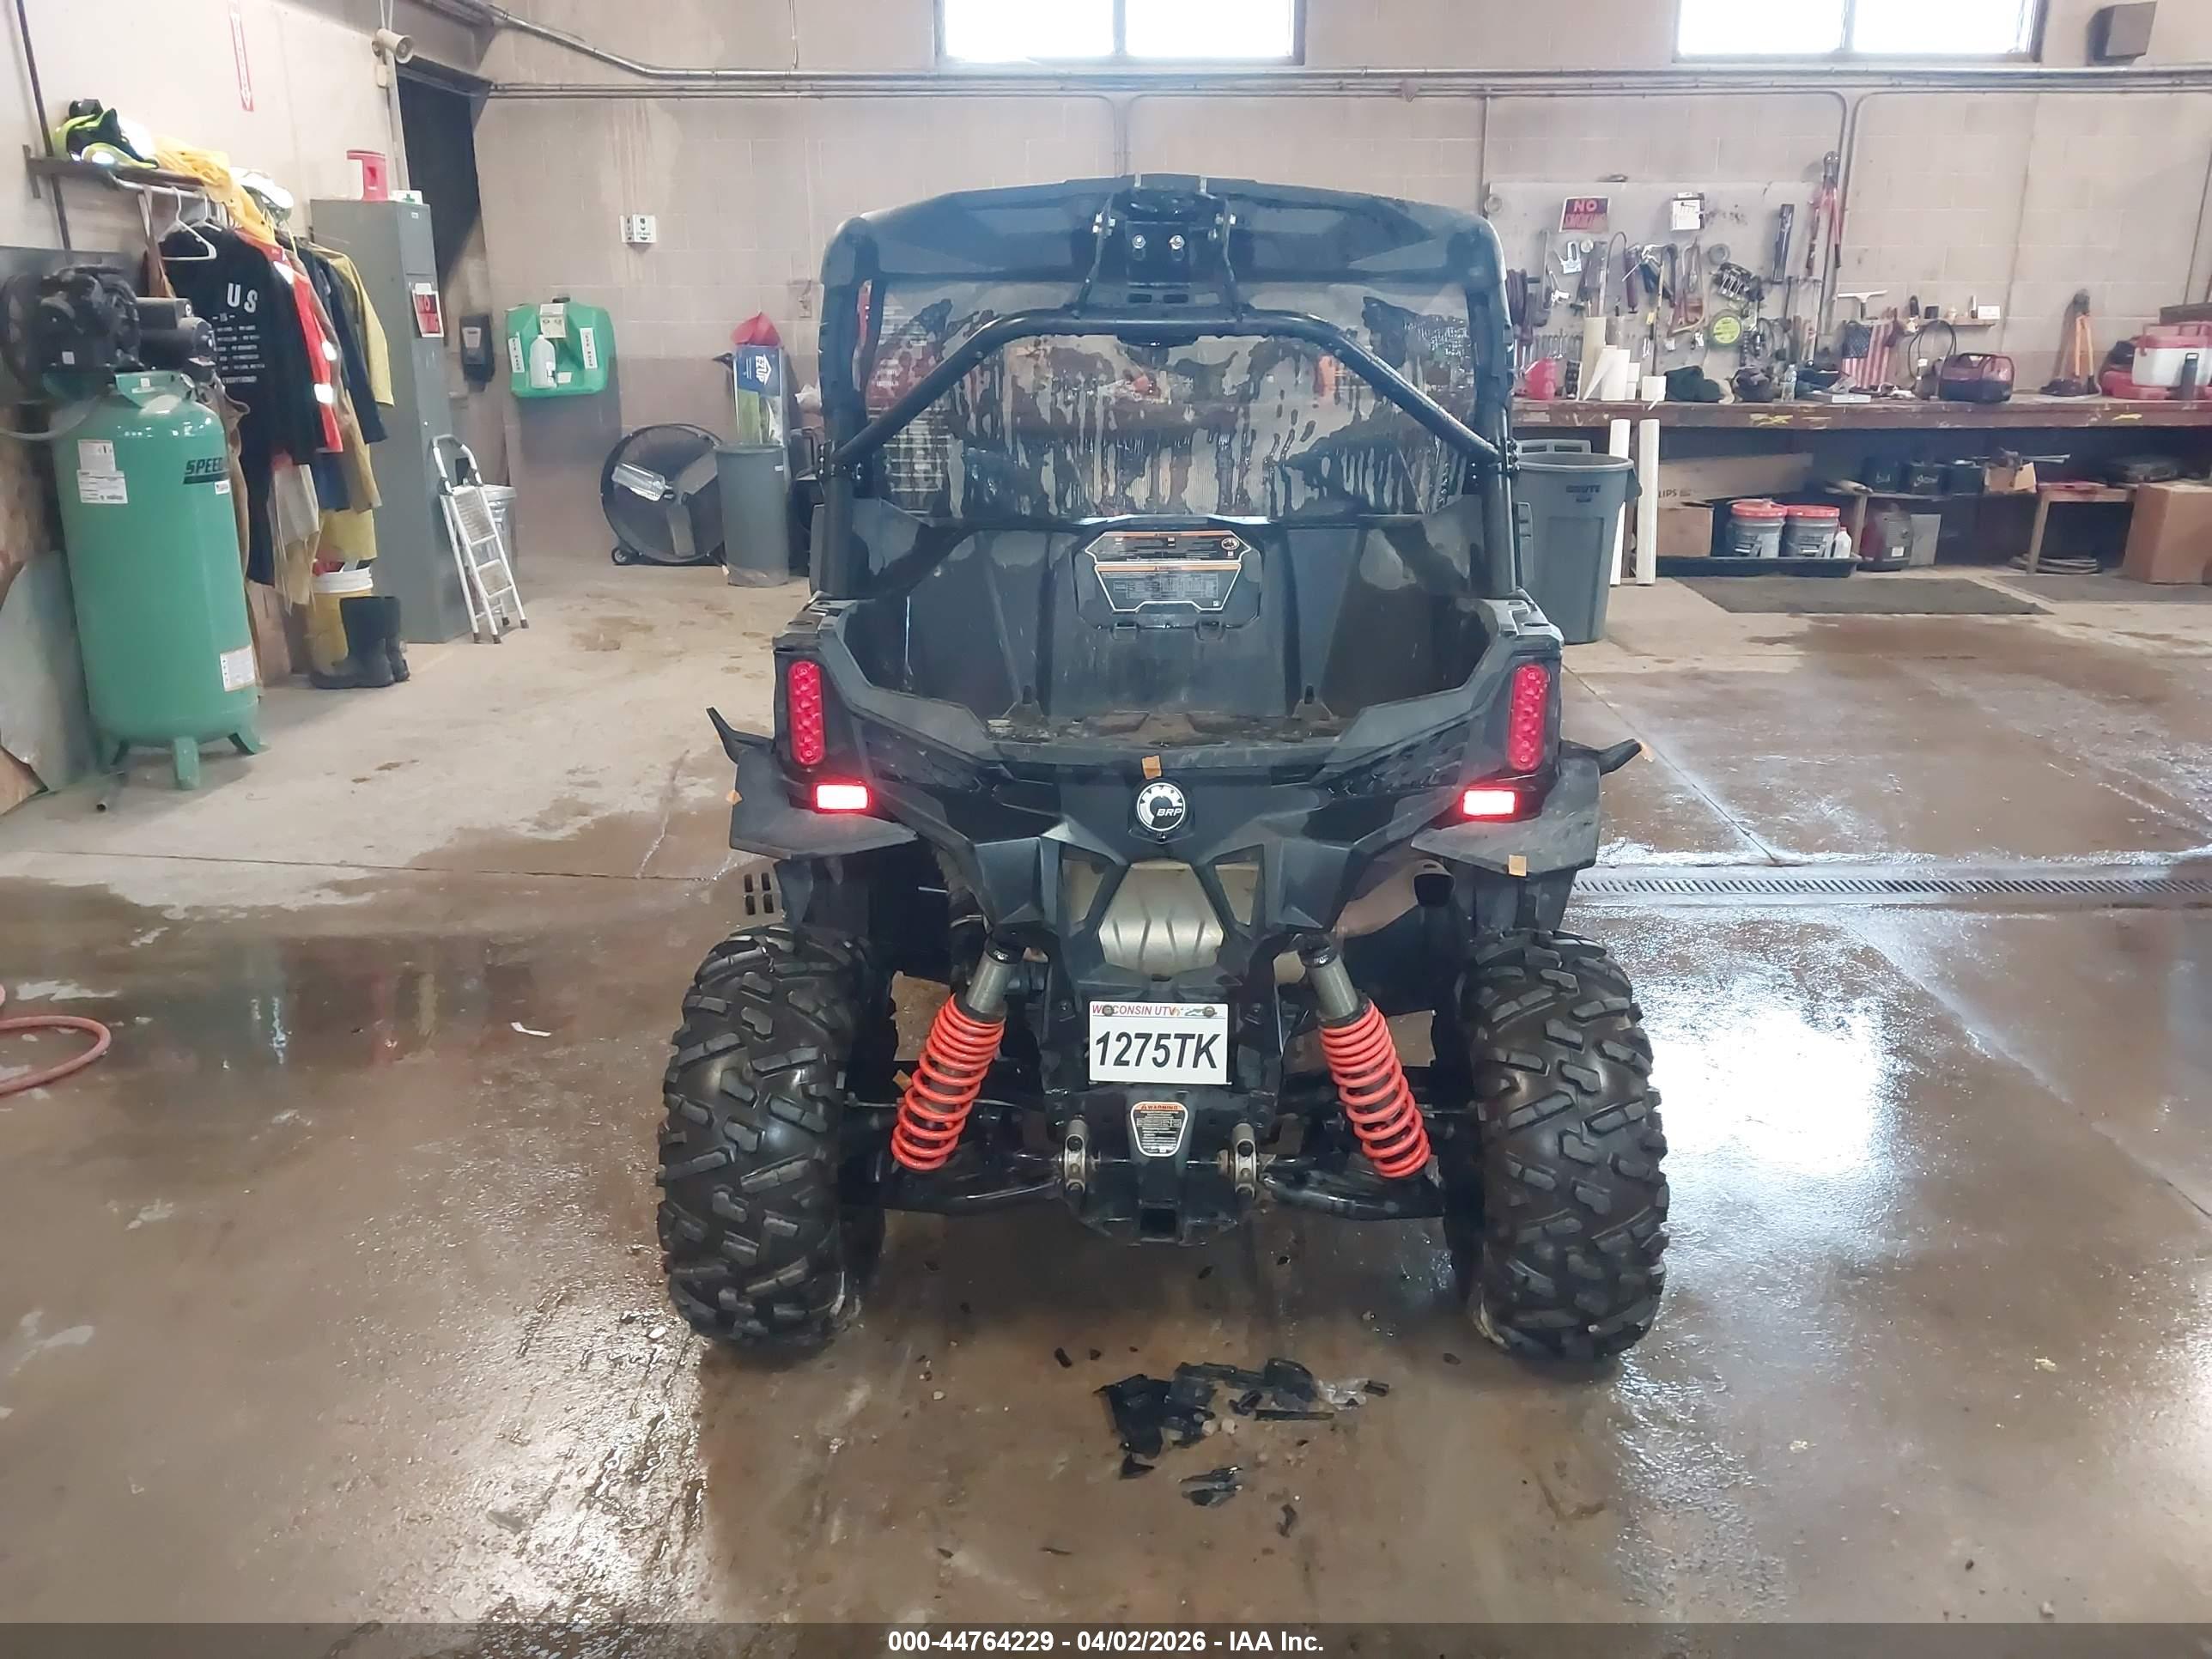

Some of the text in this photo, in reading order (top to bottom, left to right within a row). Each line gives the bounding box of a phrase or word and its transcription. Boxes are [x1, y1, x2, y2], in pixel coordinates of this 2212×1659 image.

[1573, 199, 1598, 213] NO
[1156, 807, 1182, 817] BRP
[1092, 1005, 1176, 1017] WCONSIN UTV
[1096, 1031, 1221, 1069] 1275TK
